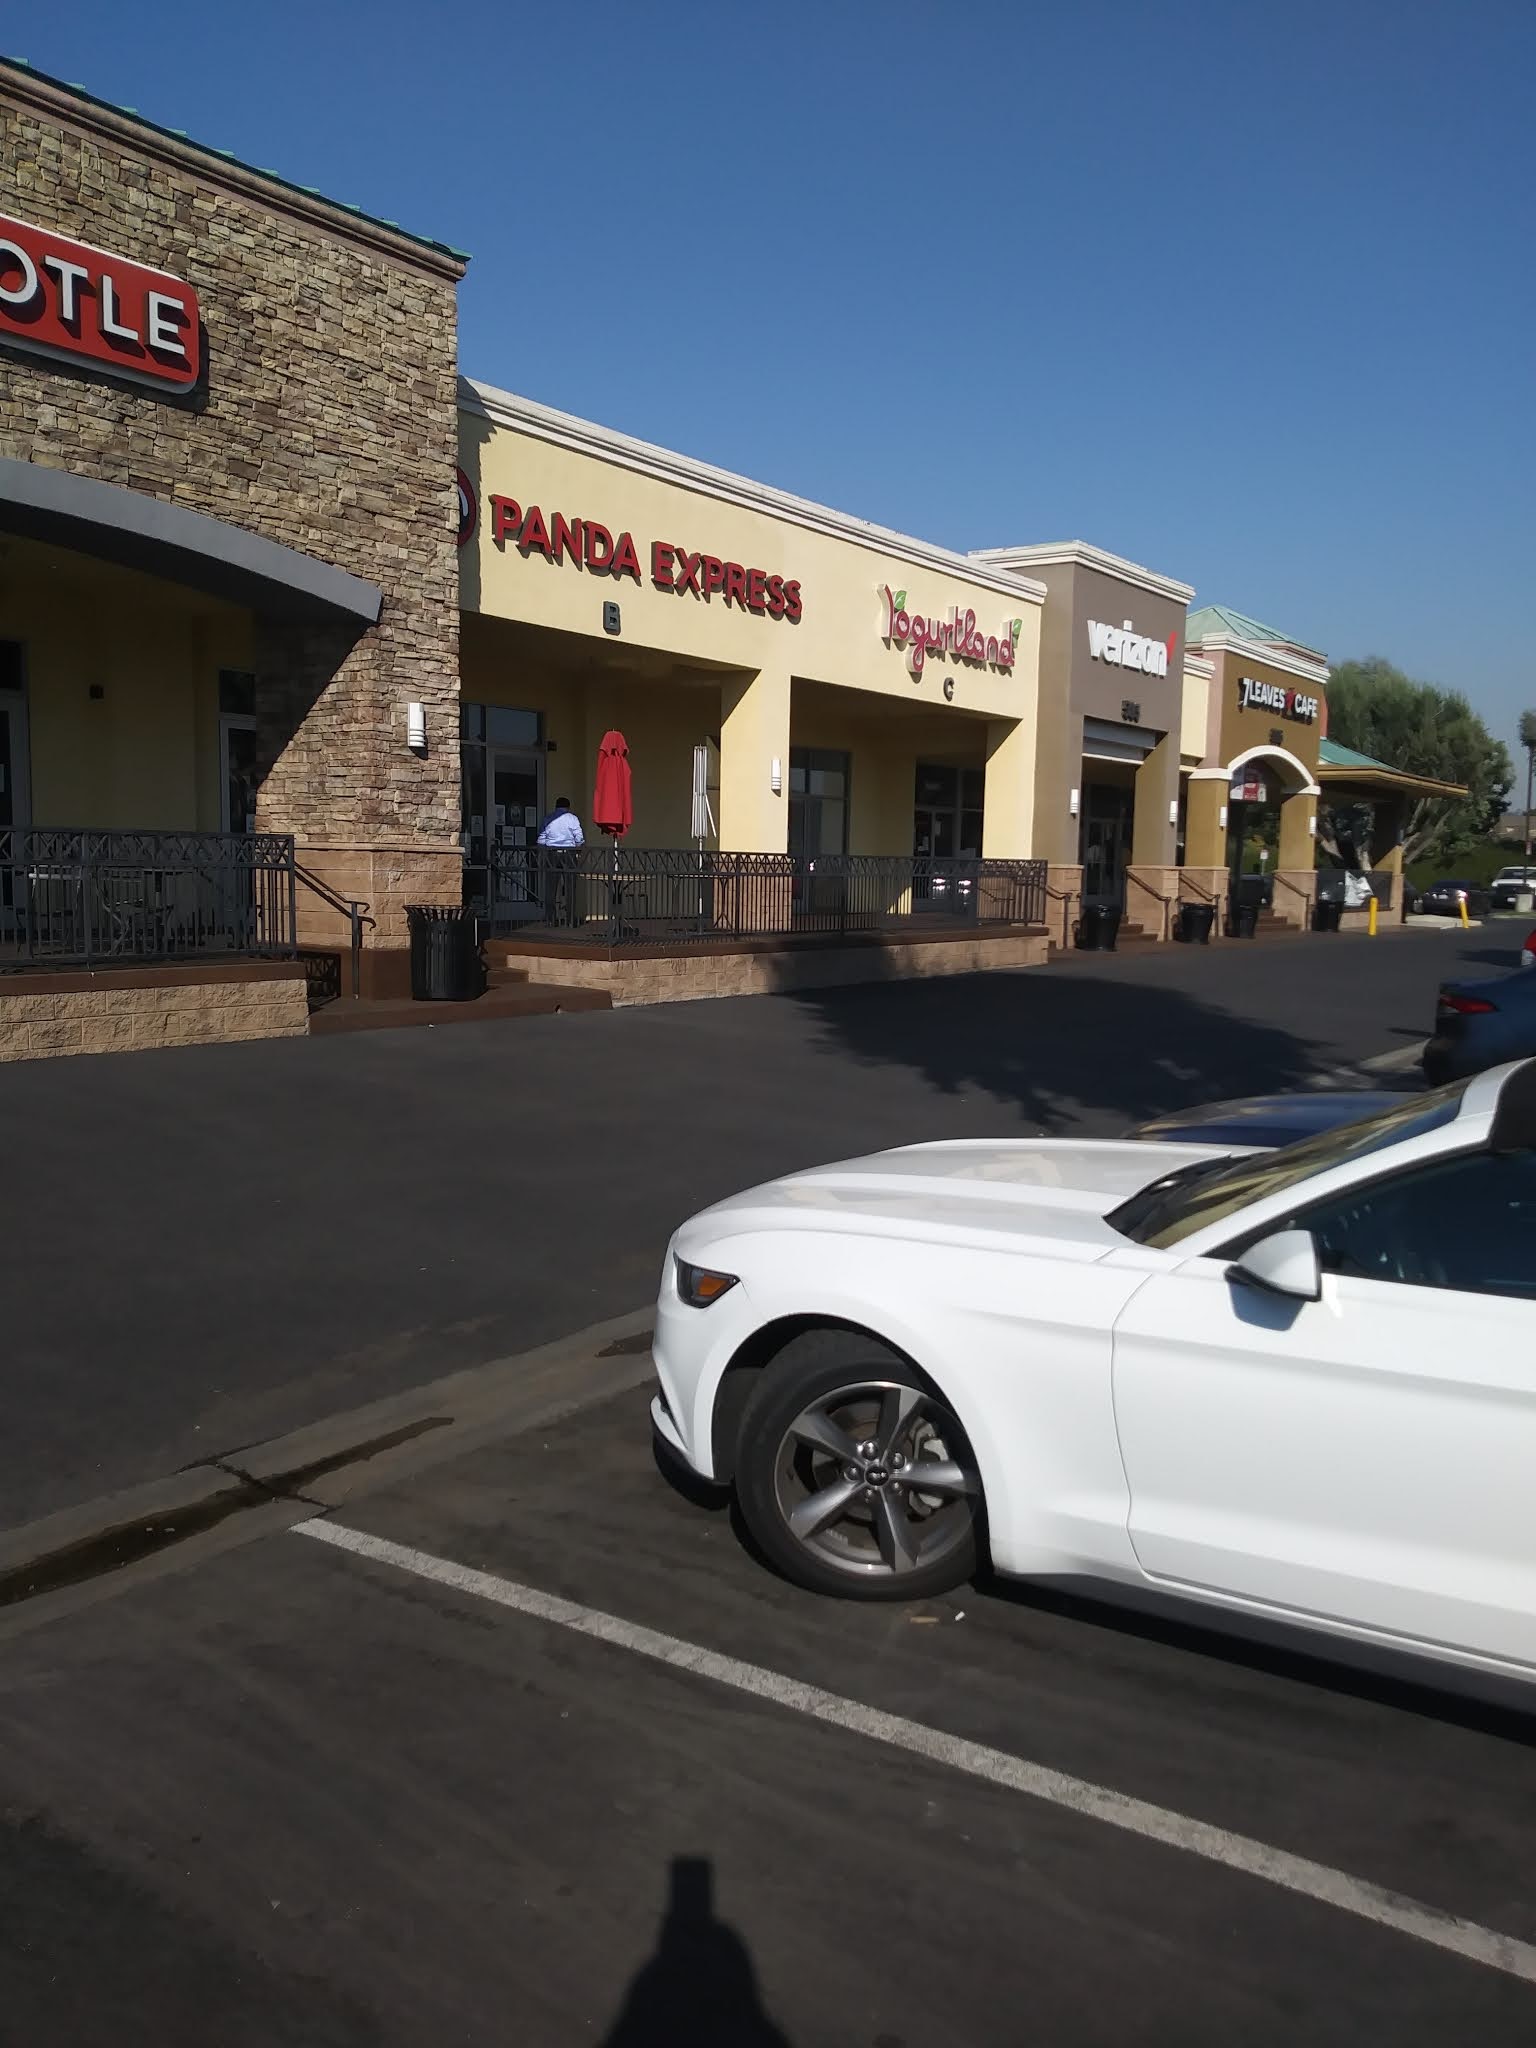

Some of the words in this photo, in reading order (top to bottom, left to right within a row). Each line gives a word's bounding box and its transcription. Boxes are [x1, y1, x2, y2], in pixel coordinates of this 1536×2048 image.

[0, 240, 186, 356] OTLE
[490, 494, 641, 579] PANDA
[651, 541, 803, 621] EXPRESS
[603, 601, 621, 635] B
[877, 584, 1017, 673] Yogurtland
[1087, 619, 1168, 677] verizon
[943, 677, 955, 702] C
[1294, 693, 1318, 718] CAFE
